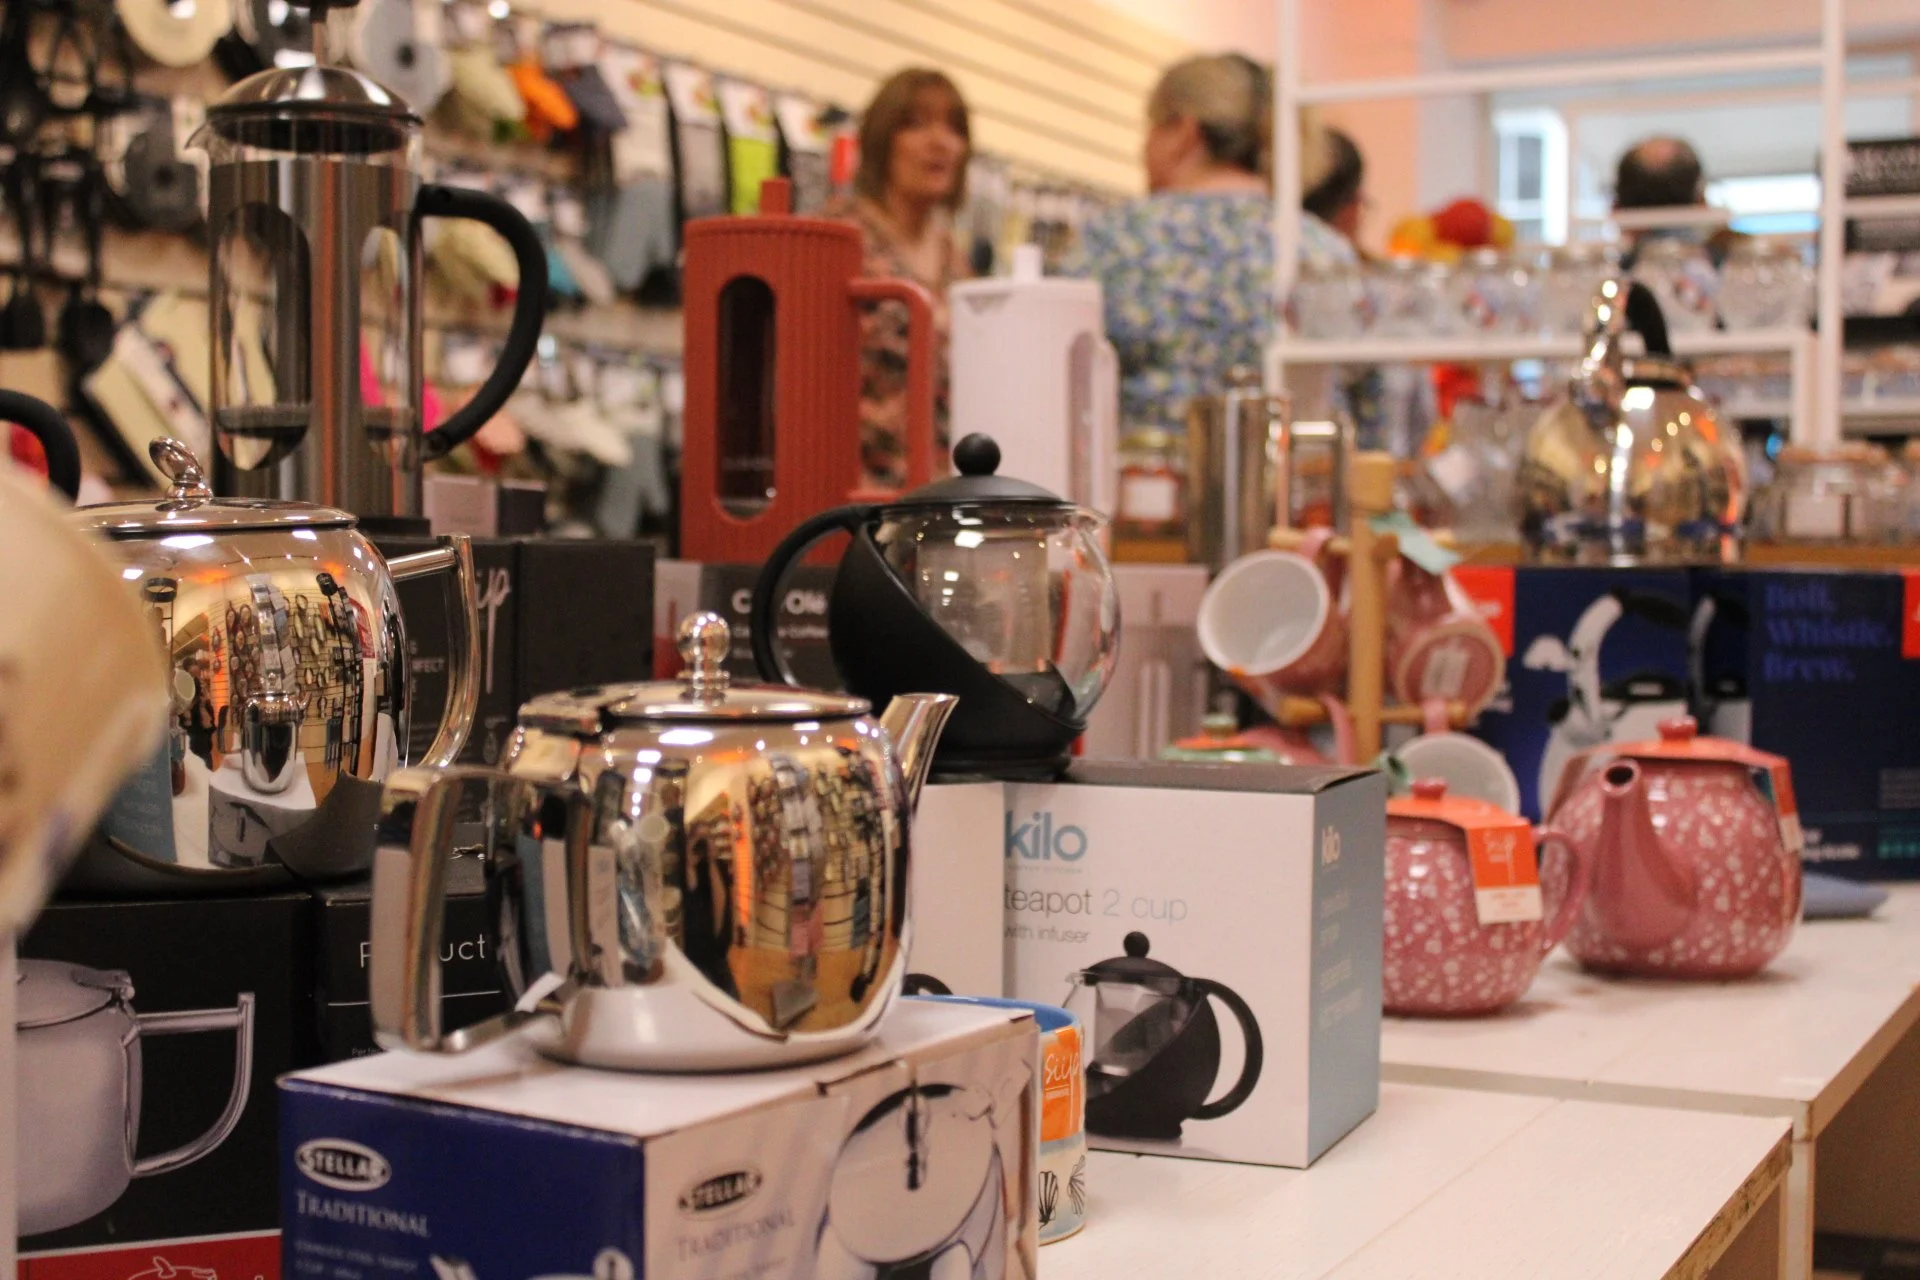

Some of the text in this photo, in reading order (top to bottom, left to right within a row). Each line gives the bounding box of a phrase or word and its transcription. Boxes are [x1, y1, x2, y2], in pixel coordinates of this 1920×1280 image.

[1004, 810, 1088, 862] kilo
[1321, 825, 1341, 868] kilo
[1004, 883, 1188, 927] teapot 2 cup
[1004, 924, 1090, 944] with infuser
[297, 1189, 430, 1238] TRADITIONAL
